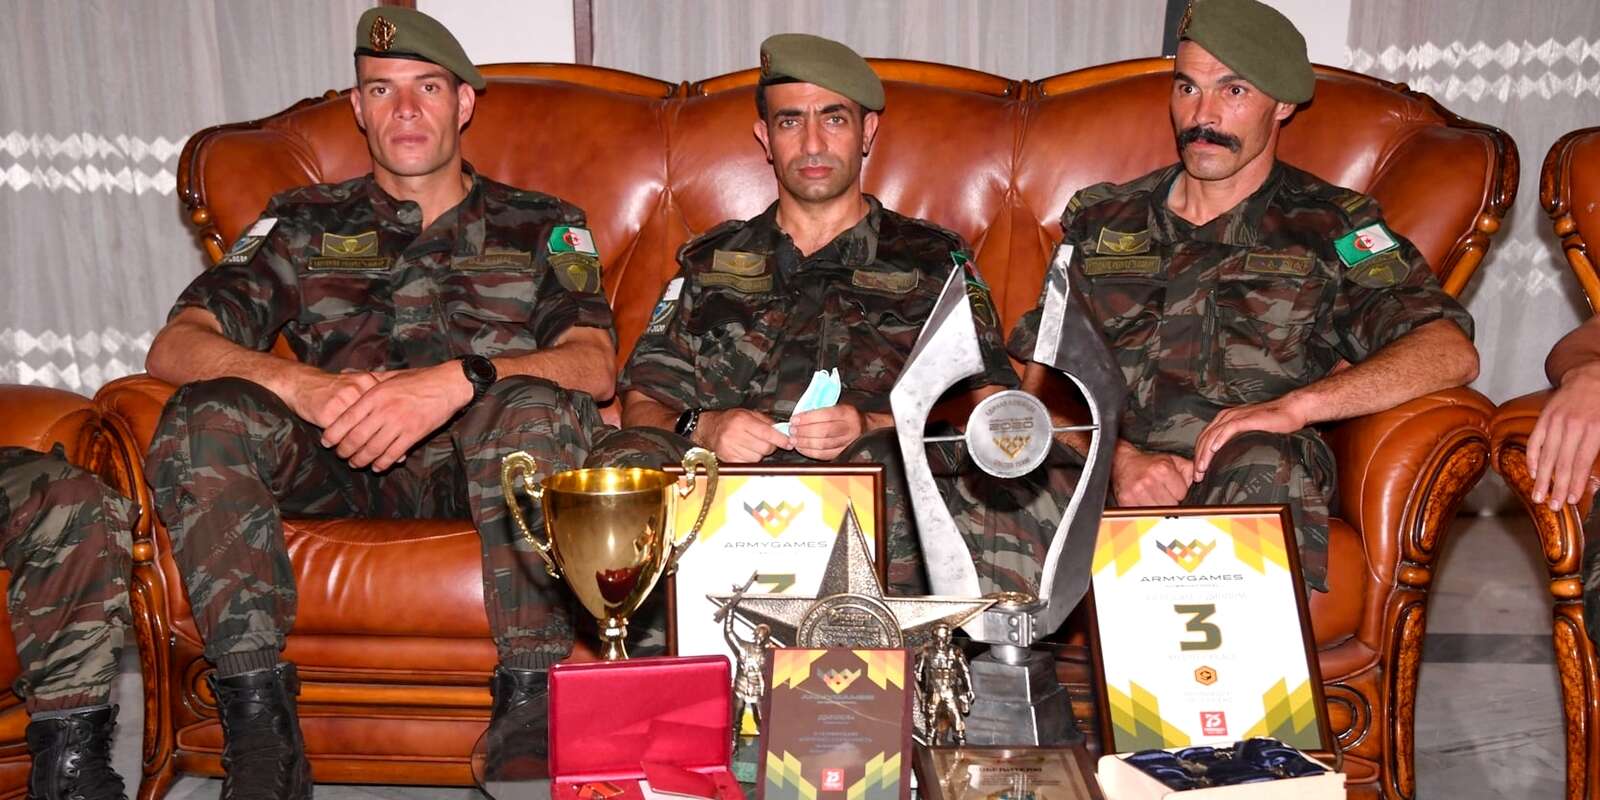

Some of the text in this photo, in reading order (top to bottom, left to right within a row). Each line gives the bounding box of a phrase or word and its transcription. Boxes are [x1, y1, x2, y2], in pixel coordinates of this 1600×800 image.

[989, 421, 1034, 431] 2020
[723, 540, 828, 549] ARMYGAMES
[1140, 574, 1244, 583] ARMYGAMES
[1174, 603, 1222, 652] 3
